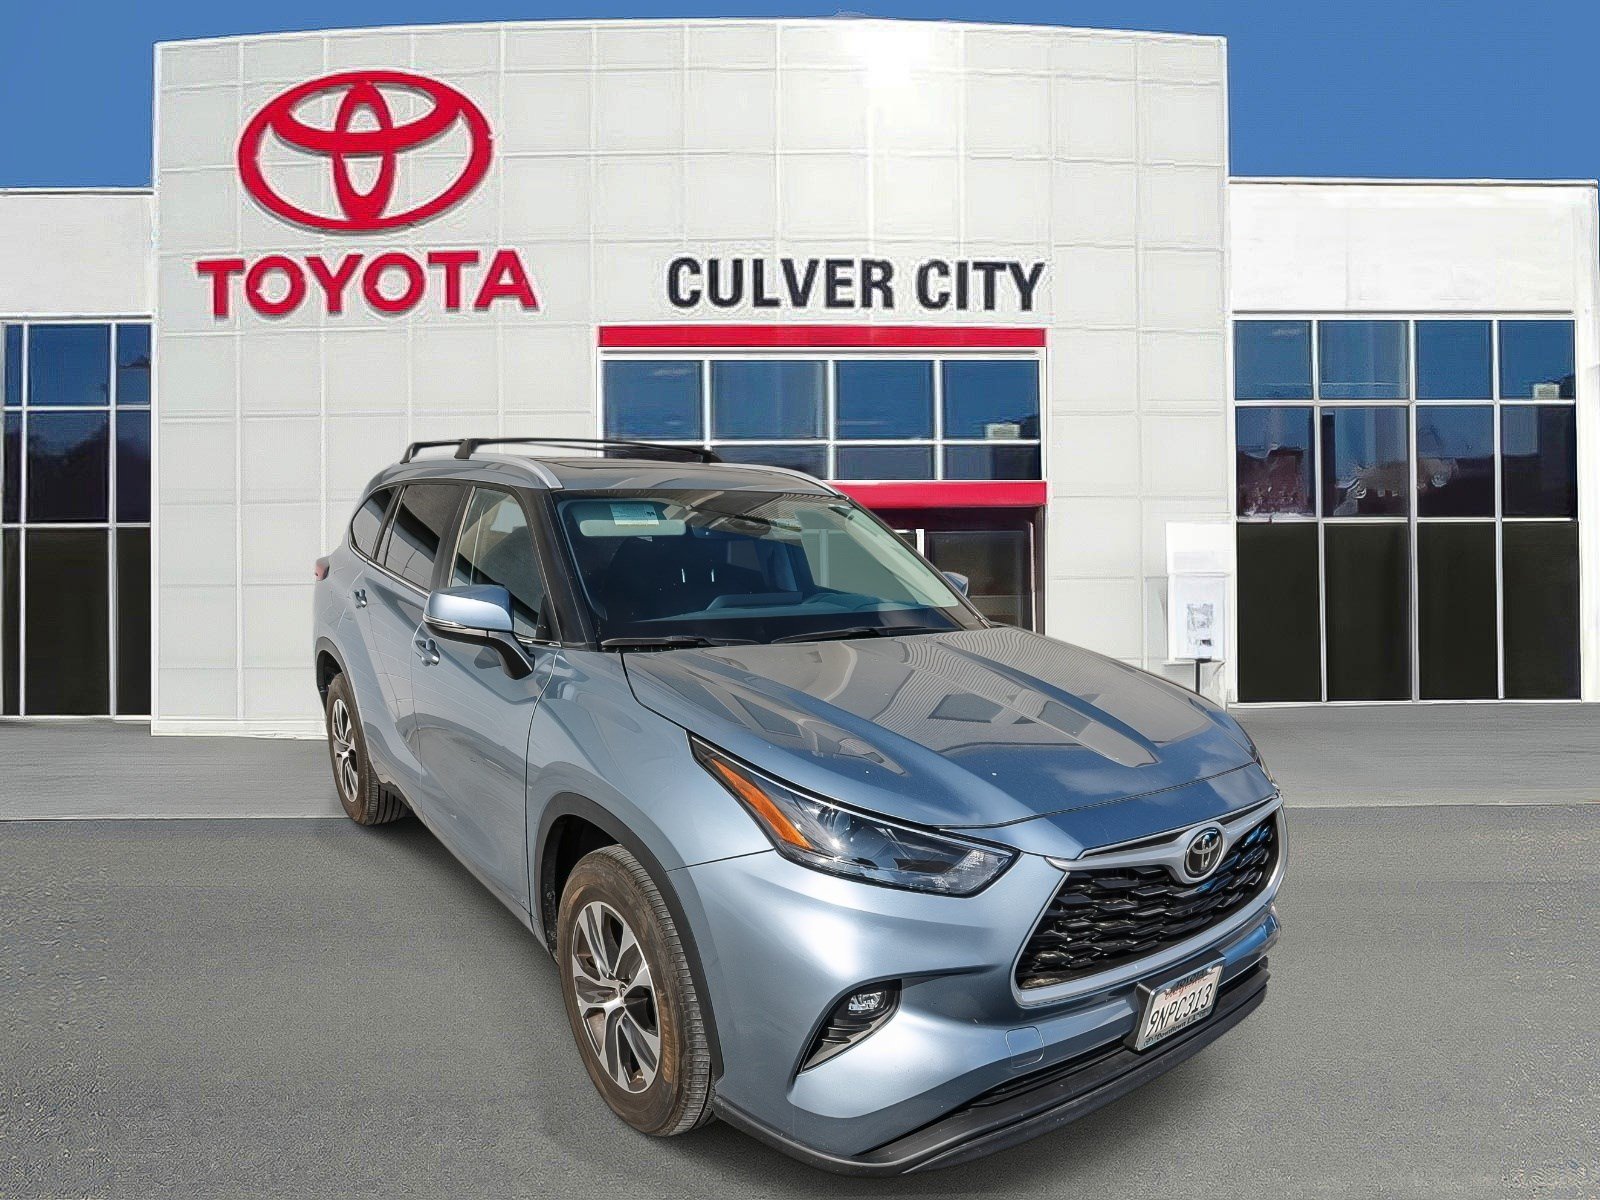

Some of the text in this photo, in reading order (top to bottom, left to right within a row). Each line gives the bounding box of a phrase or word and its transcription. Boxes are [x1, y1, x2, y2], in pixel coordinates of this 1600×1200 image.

[196, 249, 539, 317] TOYOTA
[667, 257, 1046, 311] CULVER CITY
[1145, 983, 1213, 1038] 9NPC313
